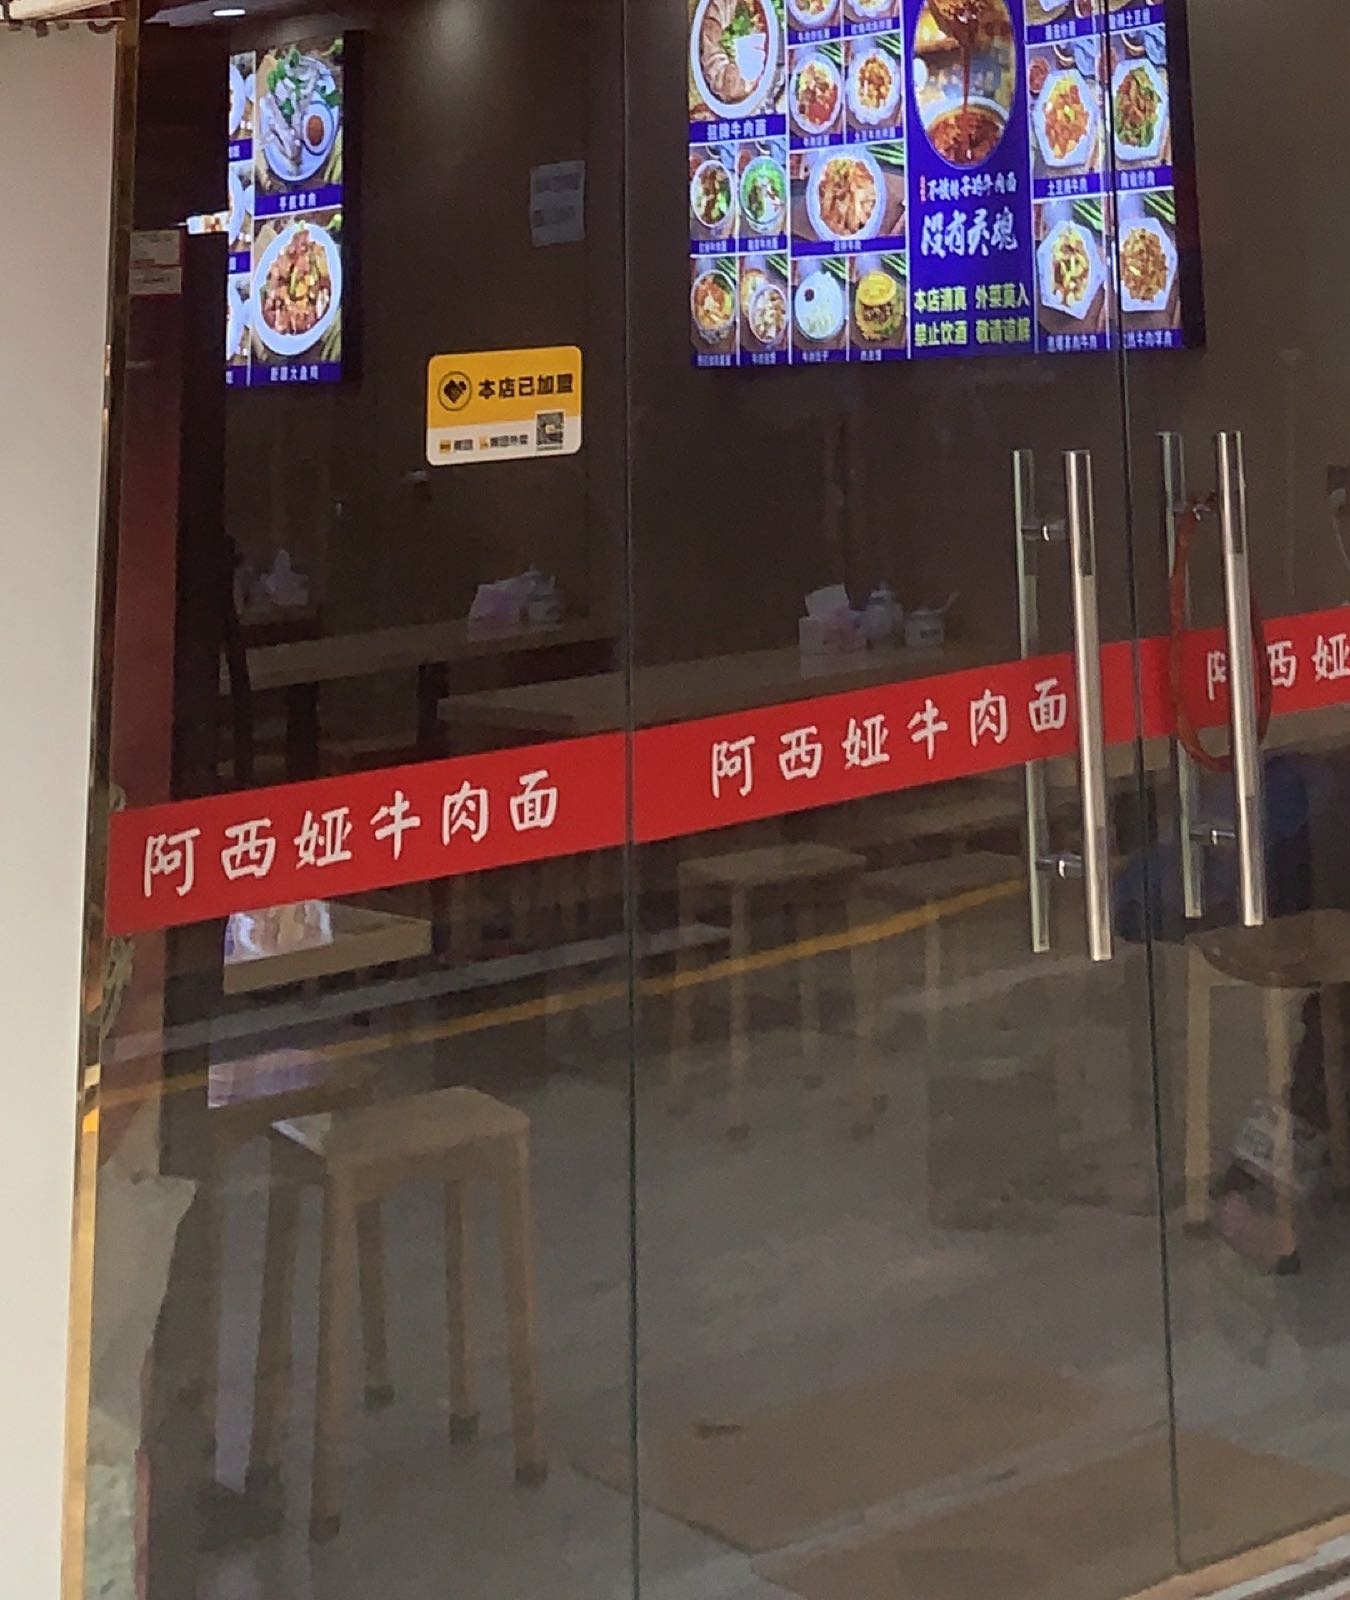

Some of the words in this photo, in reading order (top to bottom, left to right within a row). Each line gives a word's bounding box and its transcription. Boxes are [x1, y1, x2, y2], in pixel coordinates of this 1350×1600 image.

[920, 204, 1019, 260] 没有灵魂
[913, 285, 968, 314] 本店清真
[478, 373, 574, 400] 本店已加盟
[708, 675, 1070, 800] 阿西娅牛肉面
[142, 768, 560, 898] 阿西娅牛肉面
